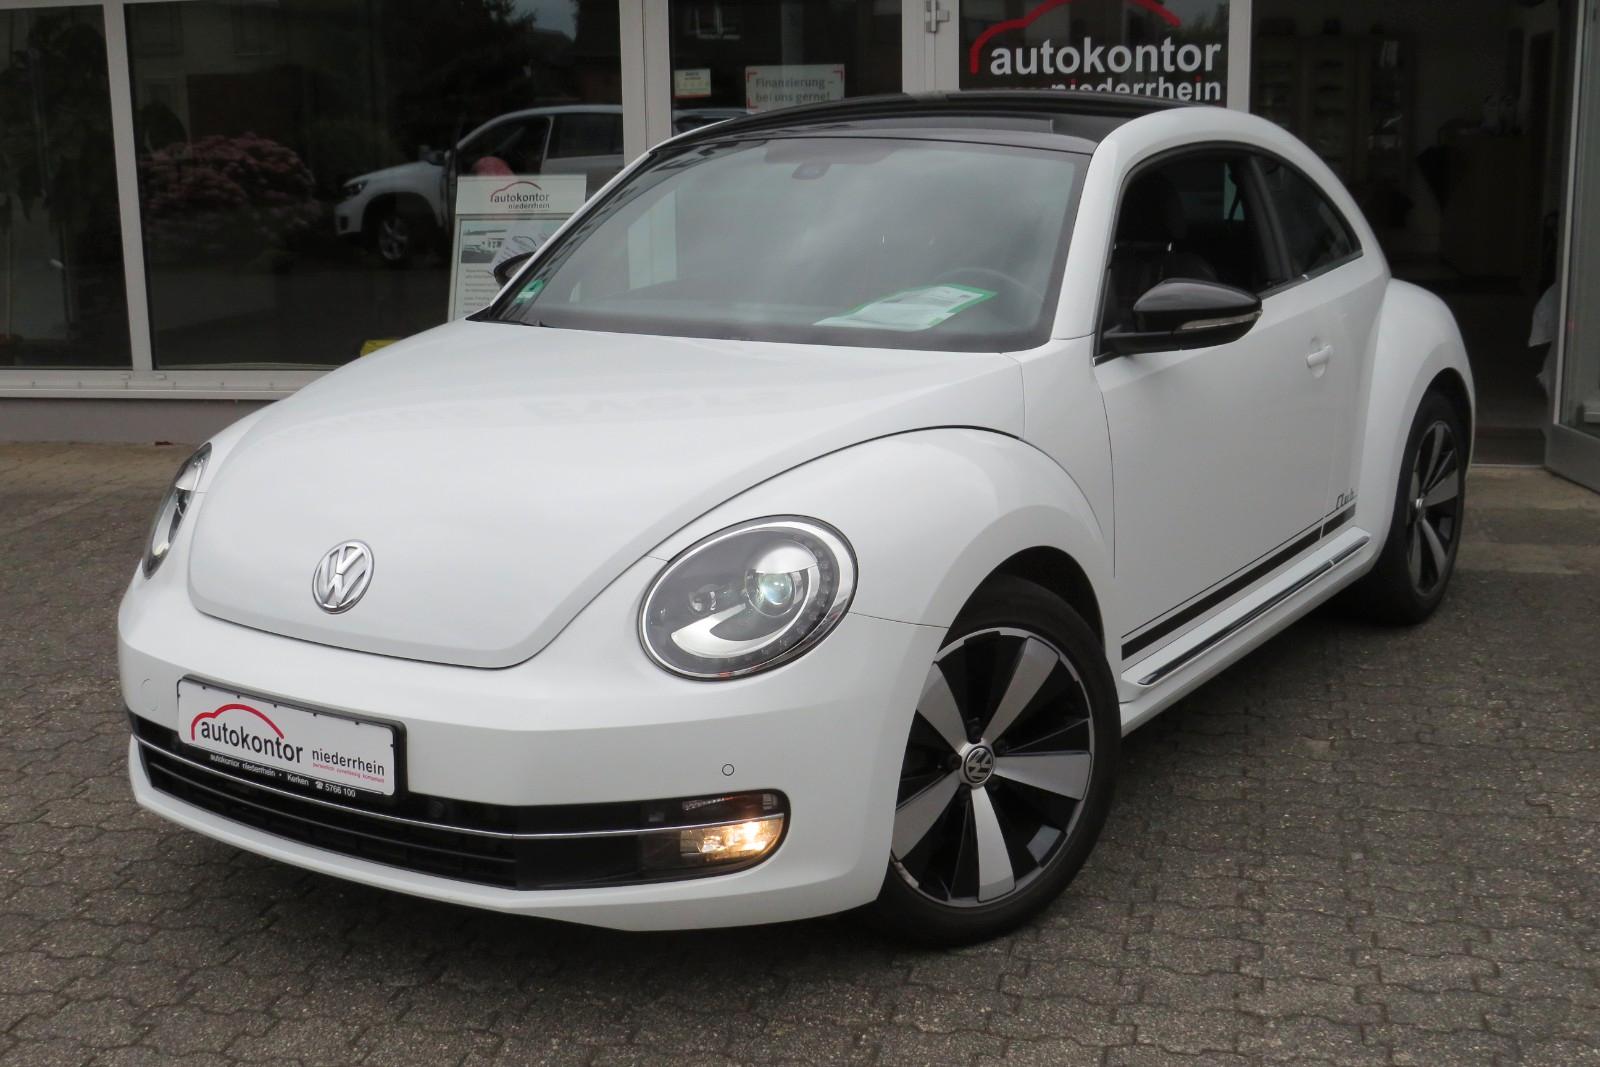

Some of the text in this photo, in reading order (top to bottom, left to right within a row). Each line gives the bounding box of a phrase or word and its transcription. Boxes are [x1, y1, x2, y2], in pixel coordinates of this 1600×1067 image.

[990, 36, 1222, 75] autokontor
[755, 77, 826, 89] Finanzierung
[755, 92, 772, 102] bei
[774, 93, 793, 102] uns
[494, 192, 550, 203] autokontor
[201, 721, 303, 763] autokontor
[312, 747, 385, 777] niederrhein
[287, 773, 309, 787] Kerken
[325, 784, 342, 795] 5766
[343, 787, 356, 798] 100
